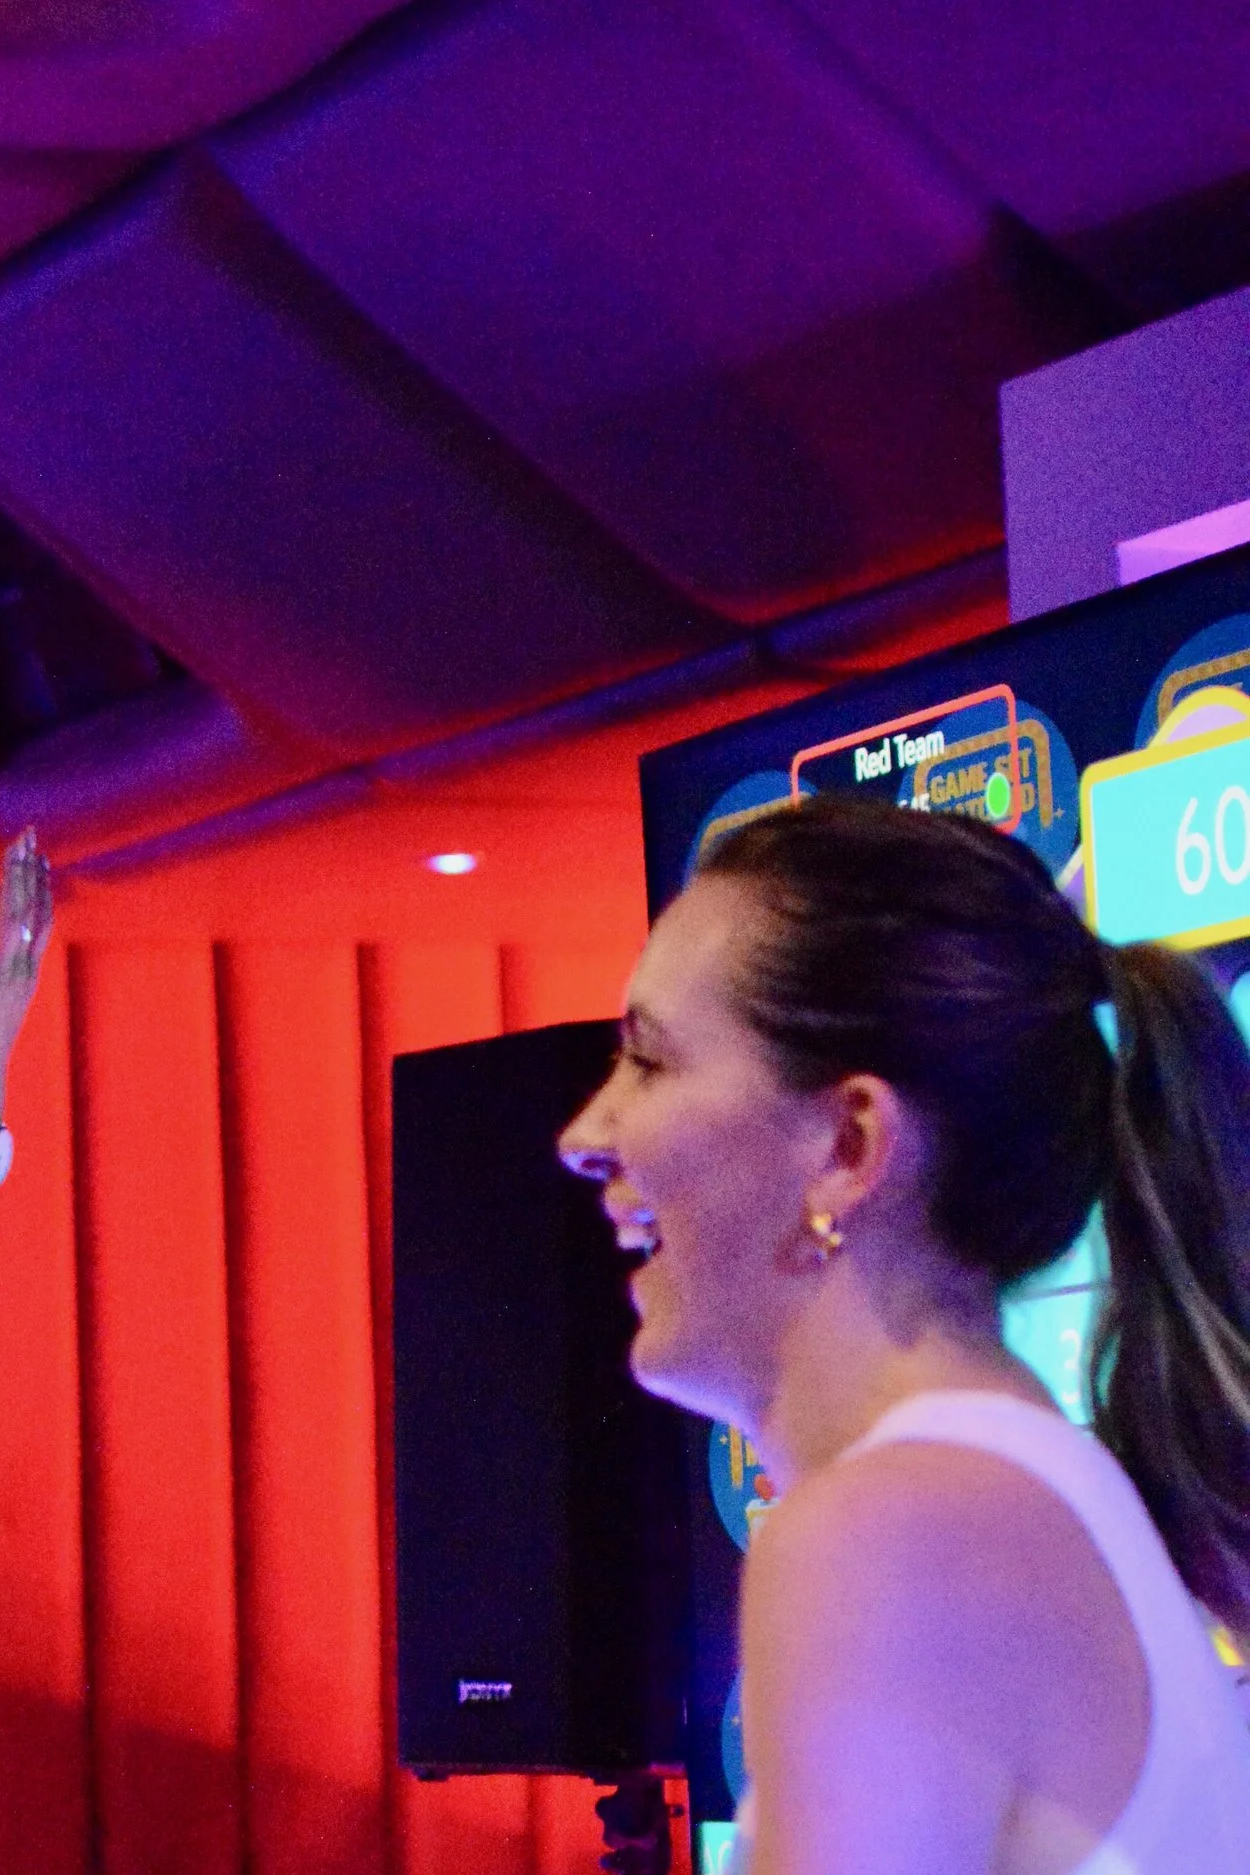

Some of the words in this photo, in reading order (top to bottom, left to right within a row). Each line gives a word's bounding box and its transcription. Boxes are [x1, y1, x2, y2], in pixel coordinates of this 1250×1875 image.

[854, 737, 892, 783] Red
[893, 730, 945, 769] Team
[929, 762, 988, 803] GAME
[993, 748, 1032, 780] ST
[1175, 785, 1250, 895] 60
